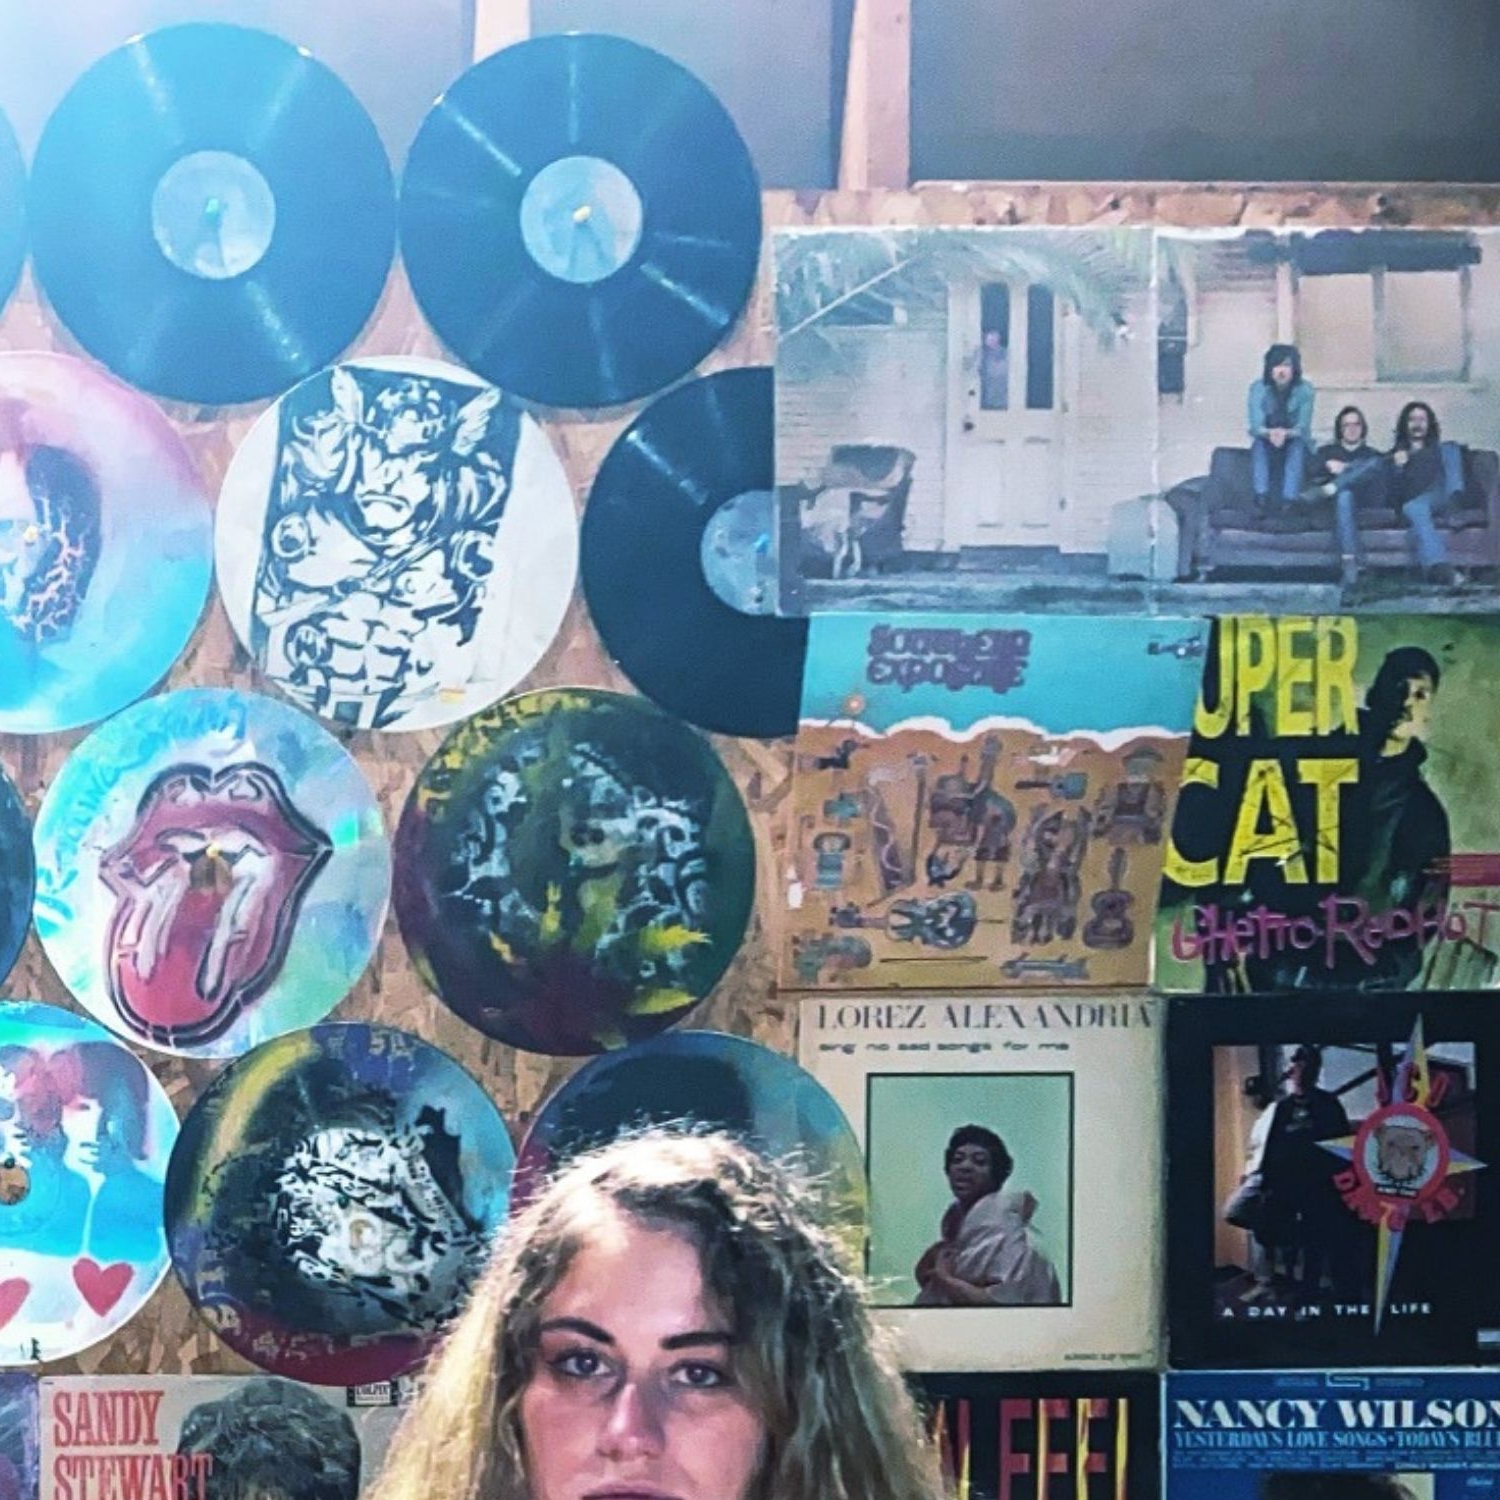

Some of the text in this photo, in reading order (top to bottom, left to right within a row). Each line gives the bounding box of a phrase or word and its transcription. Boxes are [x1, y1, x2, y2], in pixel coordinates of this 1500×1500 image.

[1194, 614, 1359, 738] UPER
[1162, 758, 1359, 887] CAT
[818, 1003, 1155, 1029] LOREZ ALEXANDRIA
[1221, 1302, 1431, 1317] A DAY IN THE LIFE
[53, 1390, 165, 1447] SANDY
[1173, 1399, 1327, 1429] NANCY
[1287, 1430, 1329, 1448] LOVE
